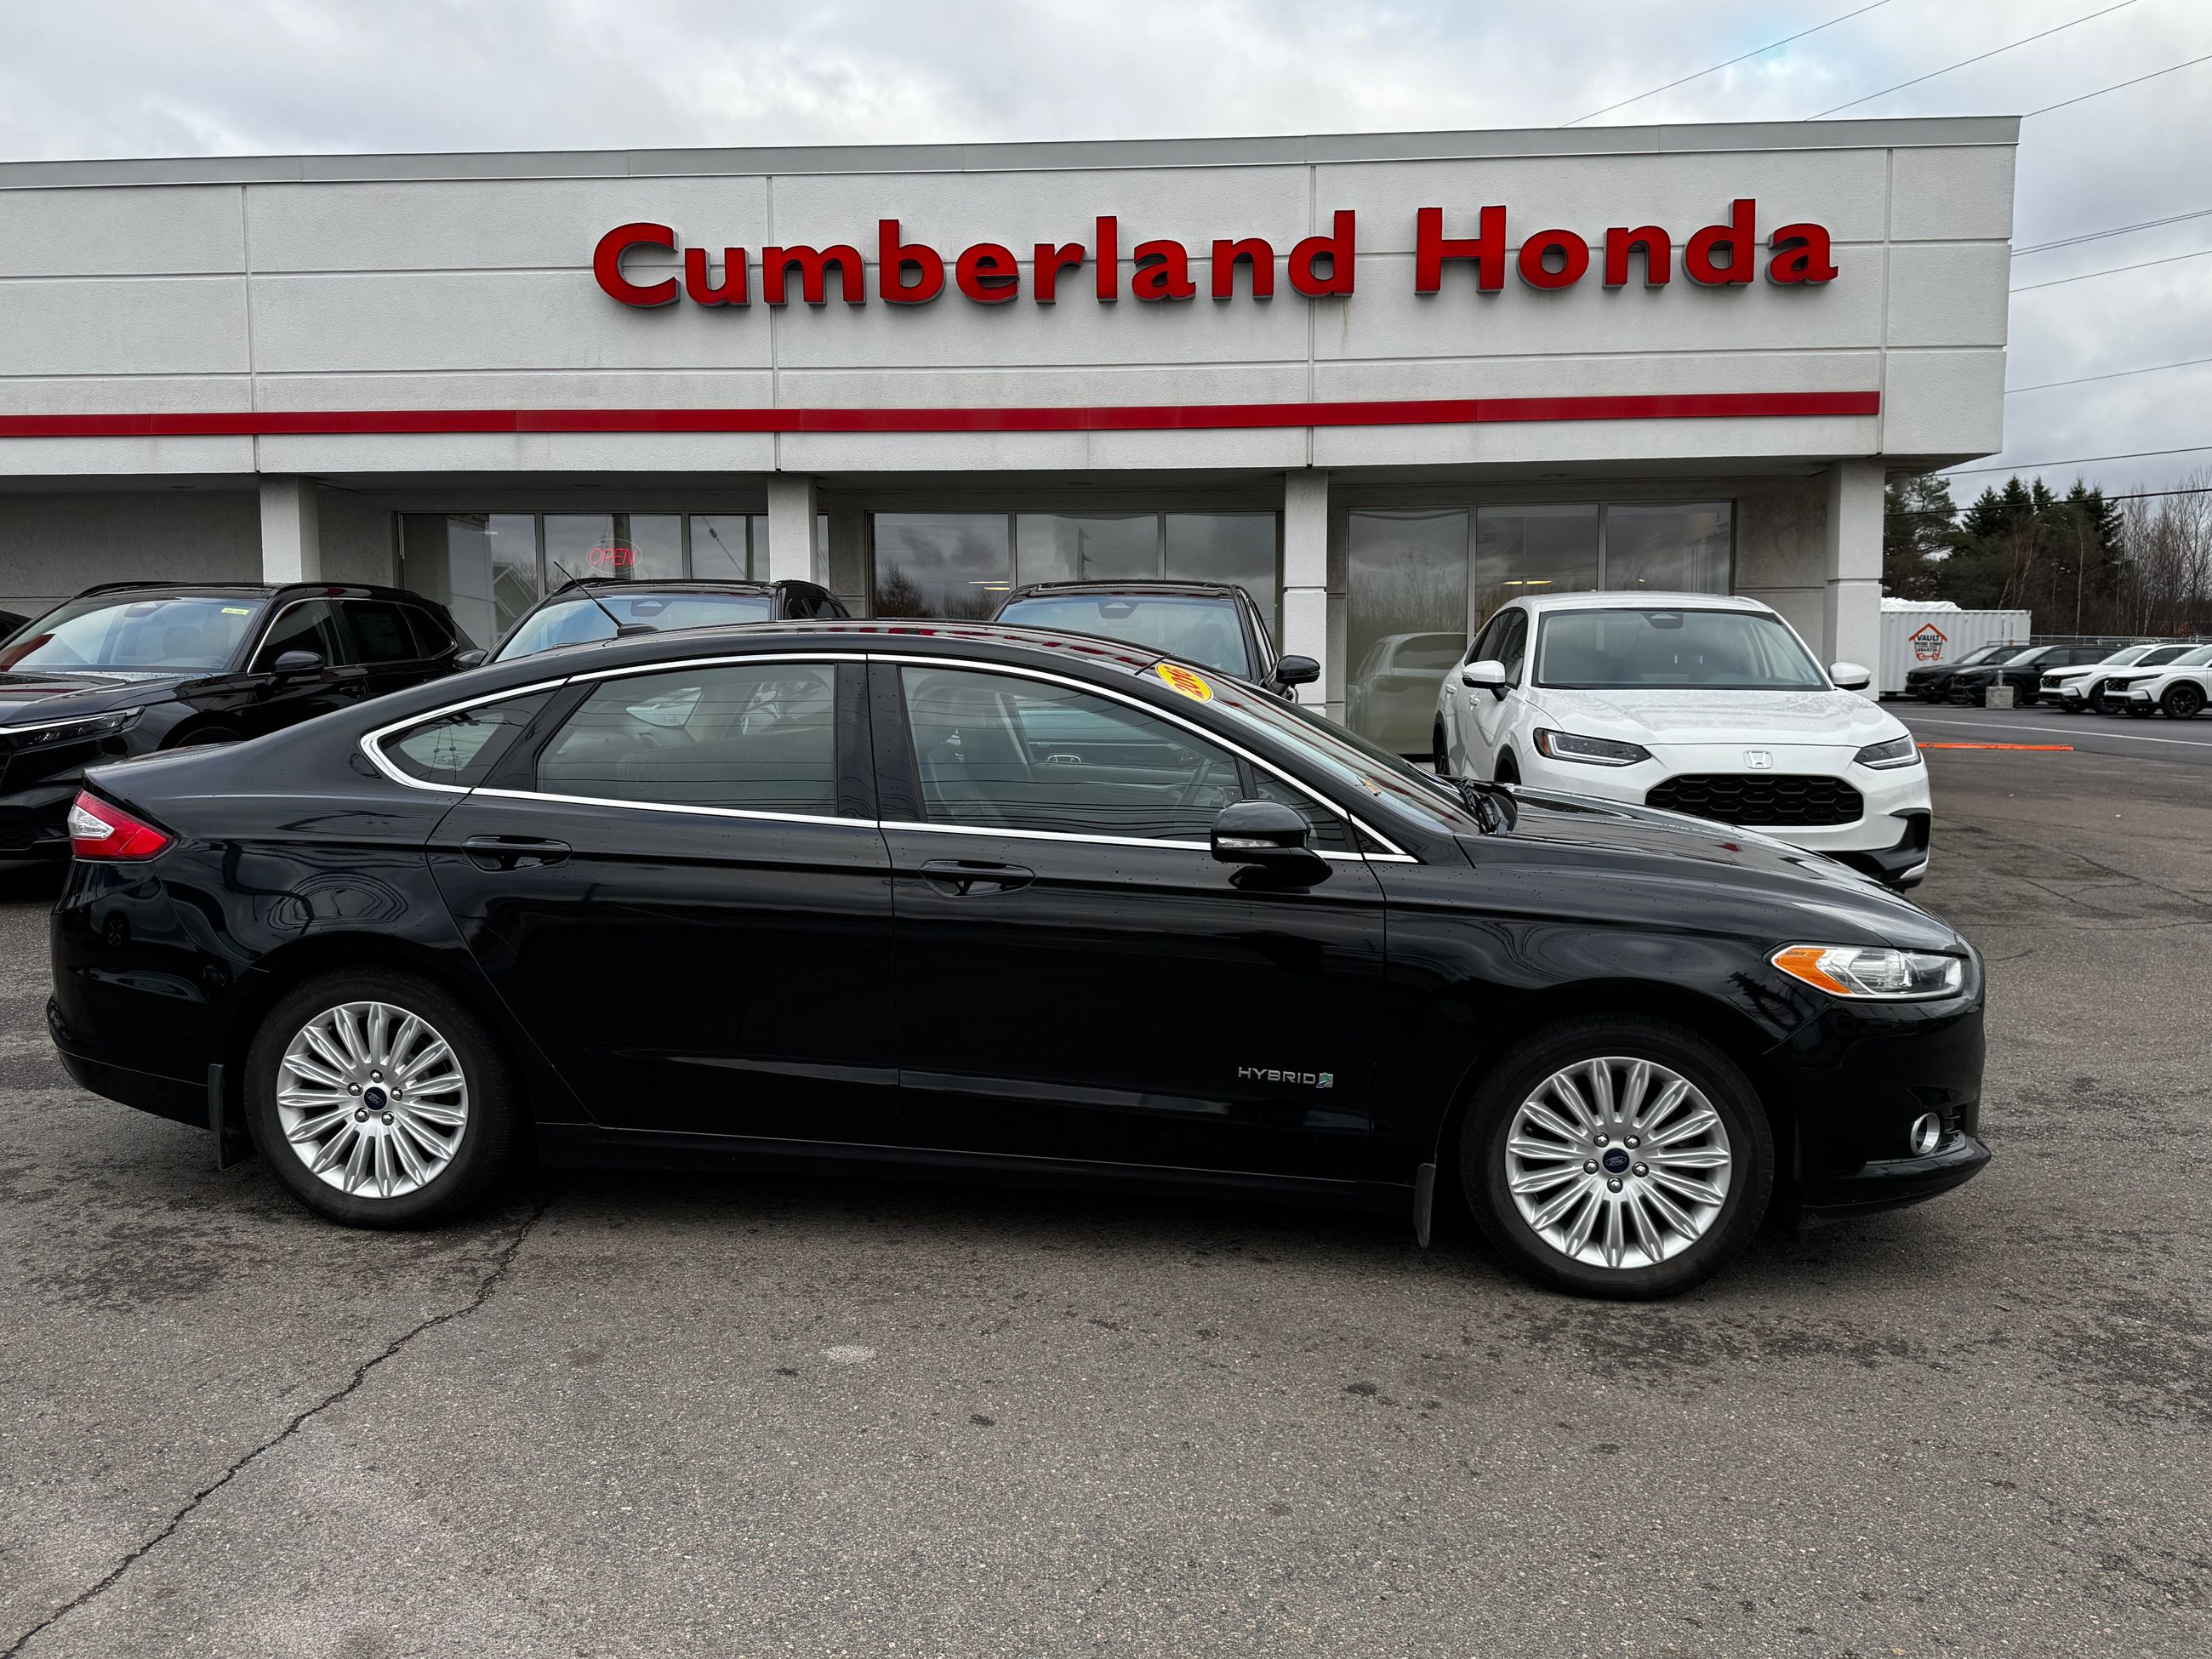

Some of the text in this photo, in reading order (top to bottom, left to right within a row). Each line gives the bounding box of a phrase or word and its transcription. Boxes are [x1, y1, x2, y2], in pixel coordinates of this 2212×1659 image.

[593, 199, 1839, 307] Cumberland Honda
[588, 547, 638, 569] OPEN
[1238, 1066, 1316, 1085] HYBRID
